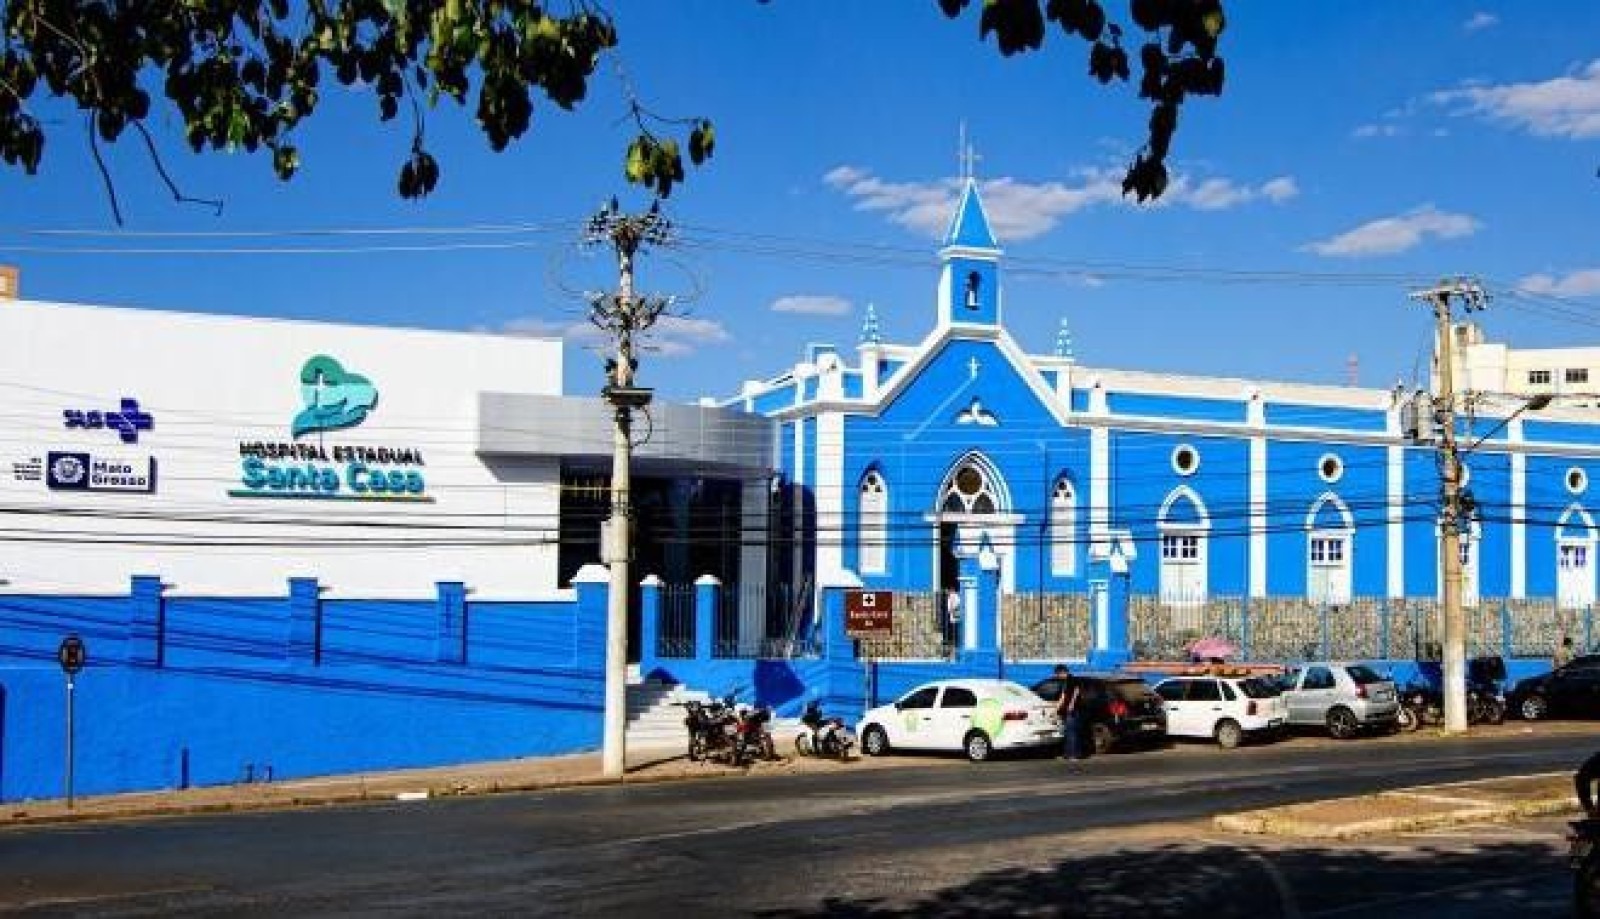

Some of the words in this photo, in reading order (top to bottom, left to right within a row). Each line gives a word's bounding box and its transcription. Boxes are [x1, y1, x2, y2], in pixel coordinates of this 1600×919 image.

[63, 409, 103, 429] SUS
[240, 441, 329, 461] HOSPITAL
[333, 445, 424, 465] ESTADUAL
[92, 462, 132, 474] Mato
[242, 456, 340, 491] Santa
[347, 460, 425, 492] Casa
[92, 474, 146, 486] Grosso
